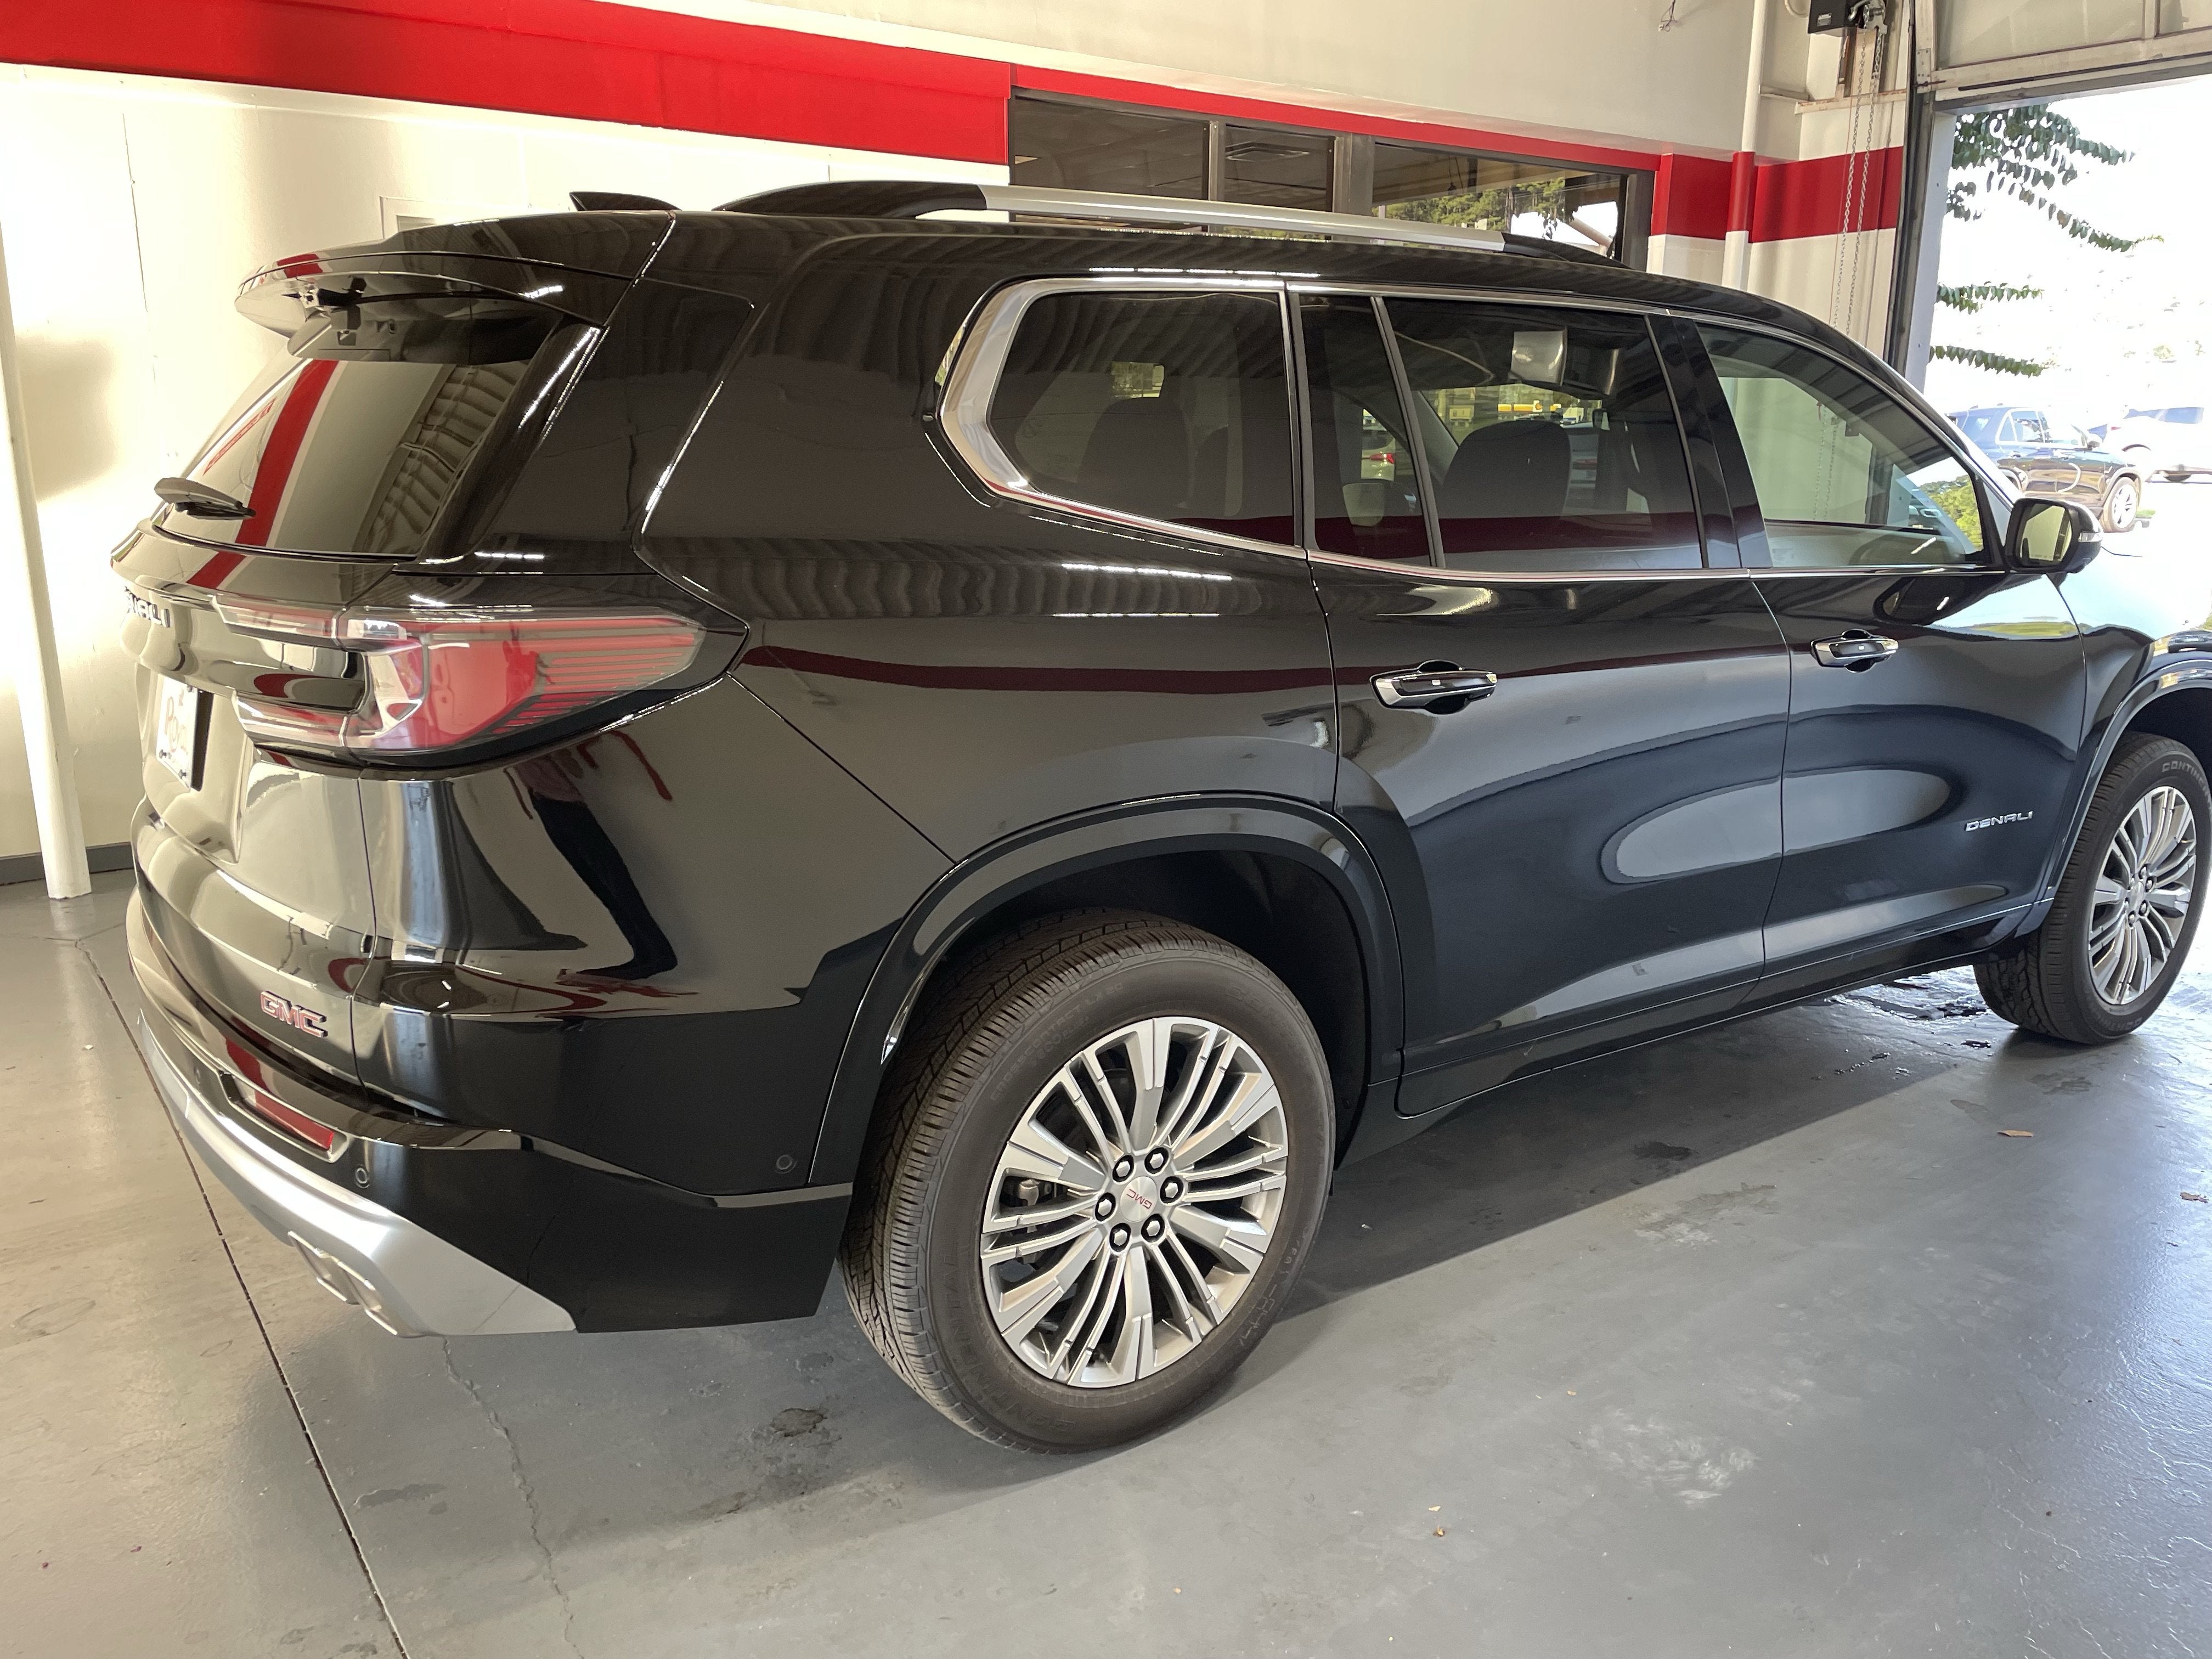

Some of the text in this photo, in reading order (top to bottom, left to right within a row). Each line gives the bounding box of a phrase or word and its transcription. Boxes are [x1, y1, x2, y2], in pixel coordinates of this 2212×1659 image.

[125, 586, 171, 628] NALI
[1965, 811, 2033, 832] DENALI
[260, 991, 328, 1038] GMC
[1126, 1188, 1152, 1209] GMC
